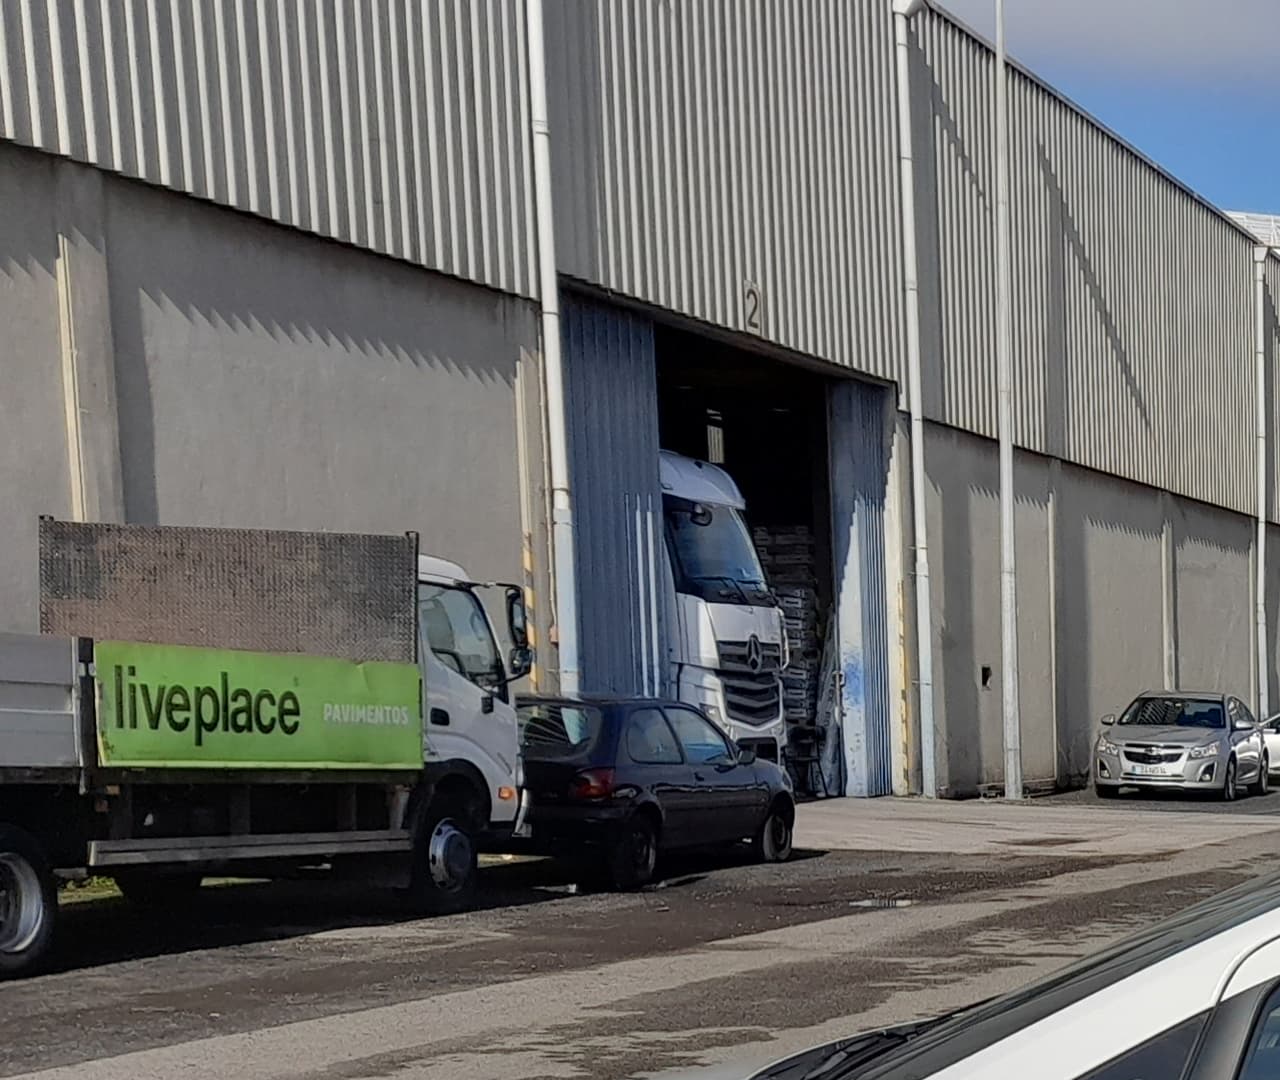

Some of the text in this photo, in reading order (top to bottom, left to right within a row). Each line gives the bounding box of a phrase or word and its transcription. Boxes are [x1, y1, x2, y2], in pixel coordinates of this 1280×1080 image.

[746, 288, 759, 329] 2
[114, 664, 409, 746] liveplace PAVIMENTOS
